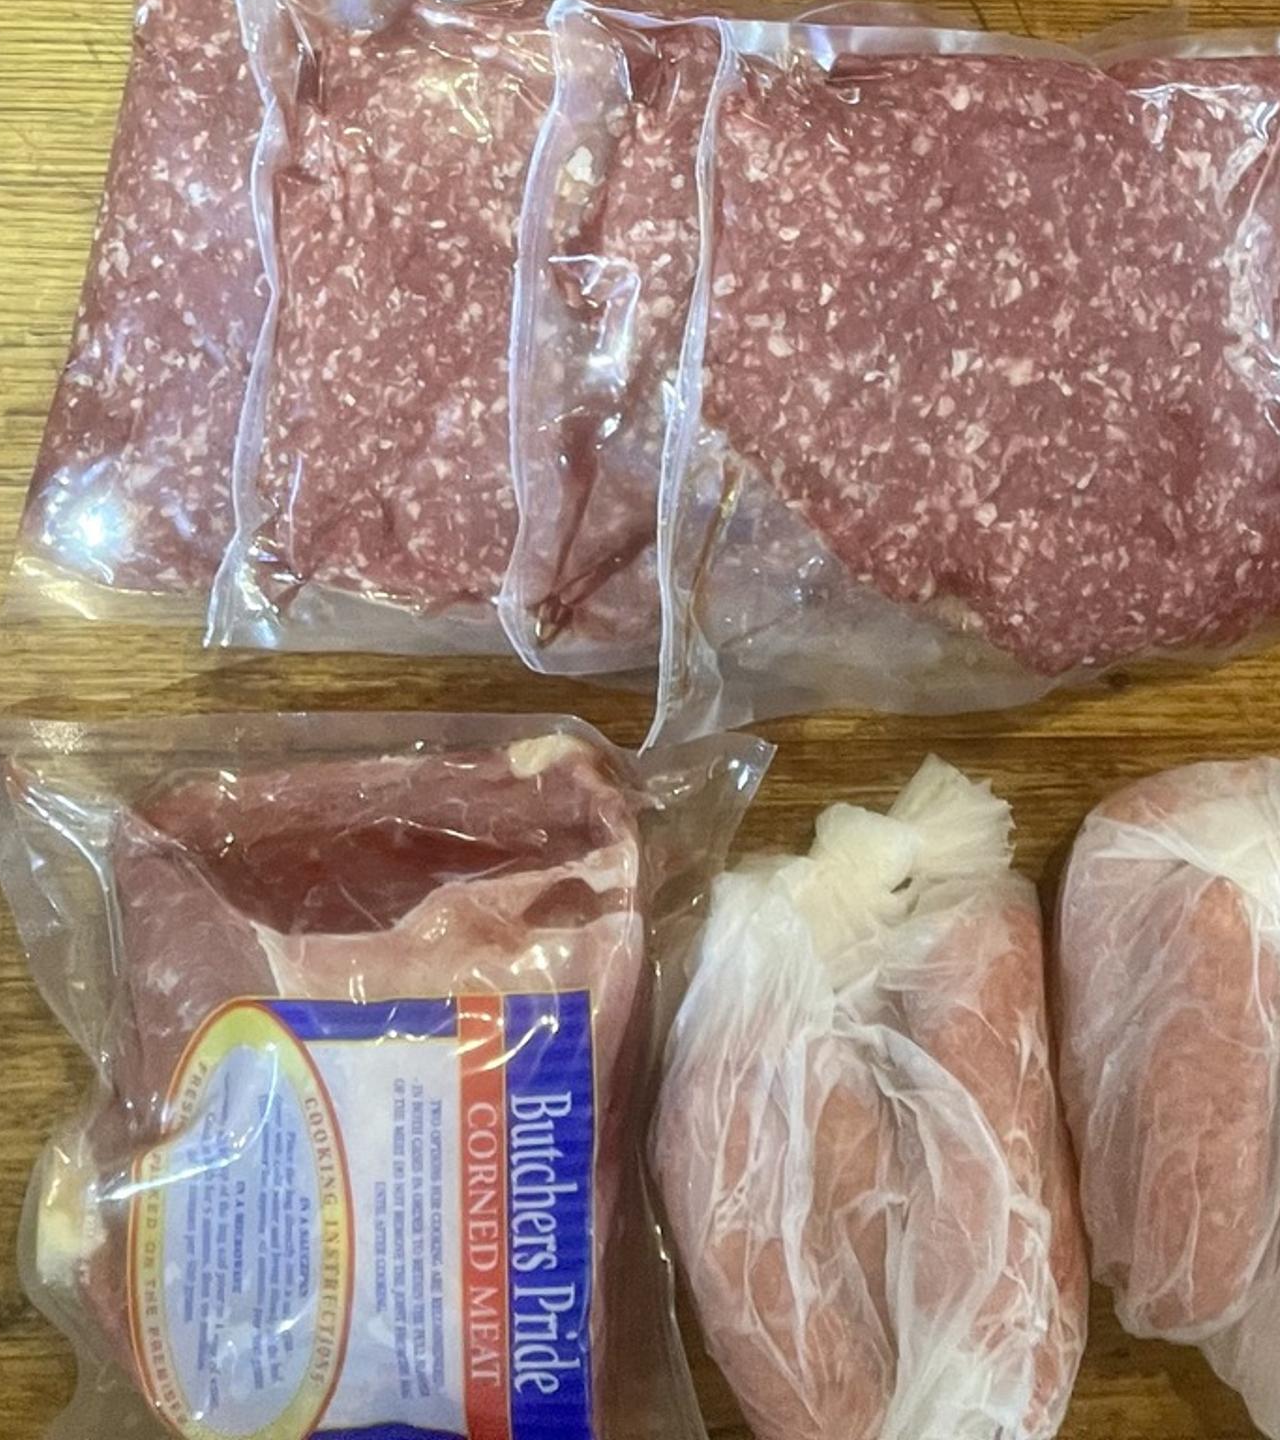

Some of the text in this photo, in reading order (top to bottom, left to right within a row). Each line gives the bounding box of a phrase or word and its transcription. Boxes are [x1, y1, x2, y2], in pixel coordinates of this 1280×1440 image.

[146, 1153, 162, 1230] PAKED
[304, 1097, 340, 1206] COOKING
[145, 1280, 158, 1315] THE
[466, 1101, 501, 1387] CORNED MEAT
[509, 1091, 581, 1396] Butchers Pride
